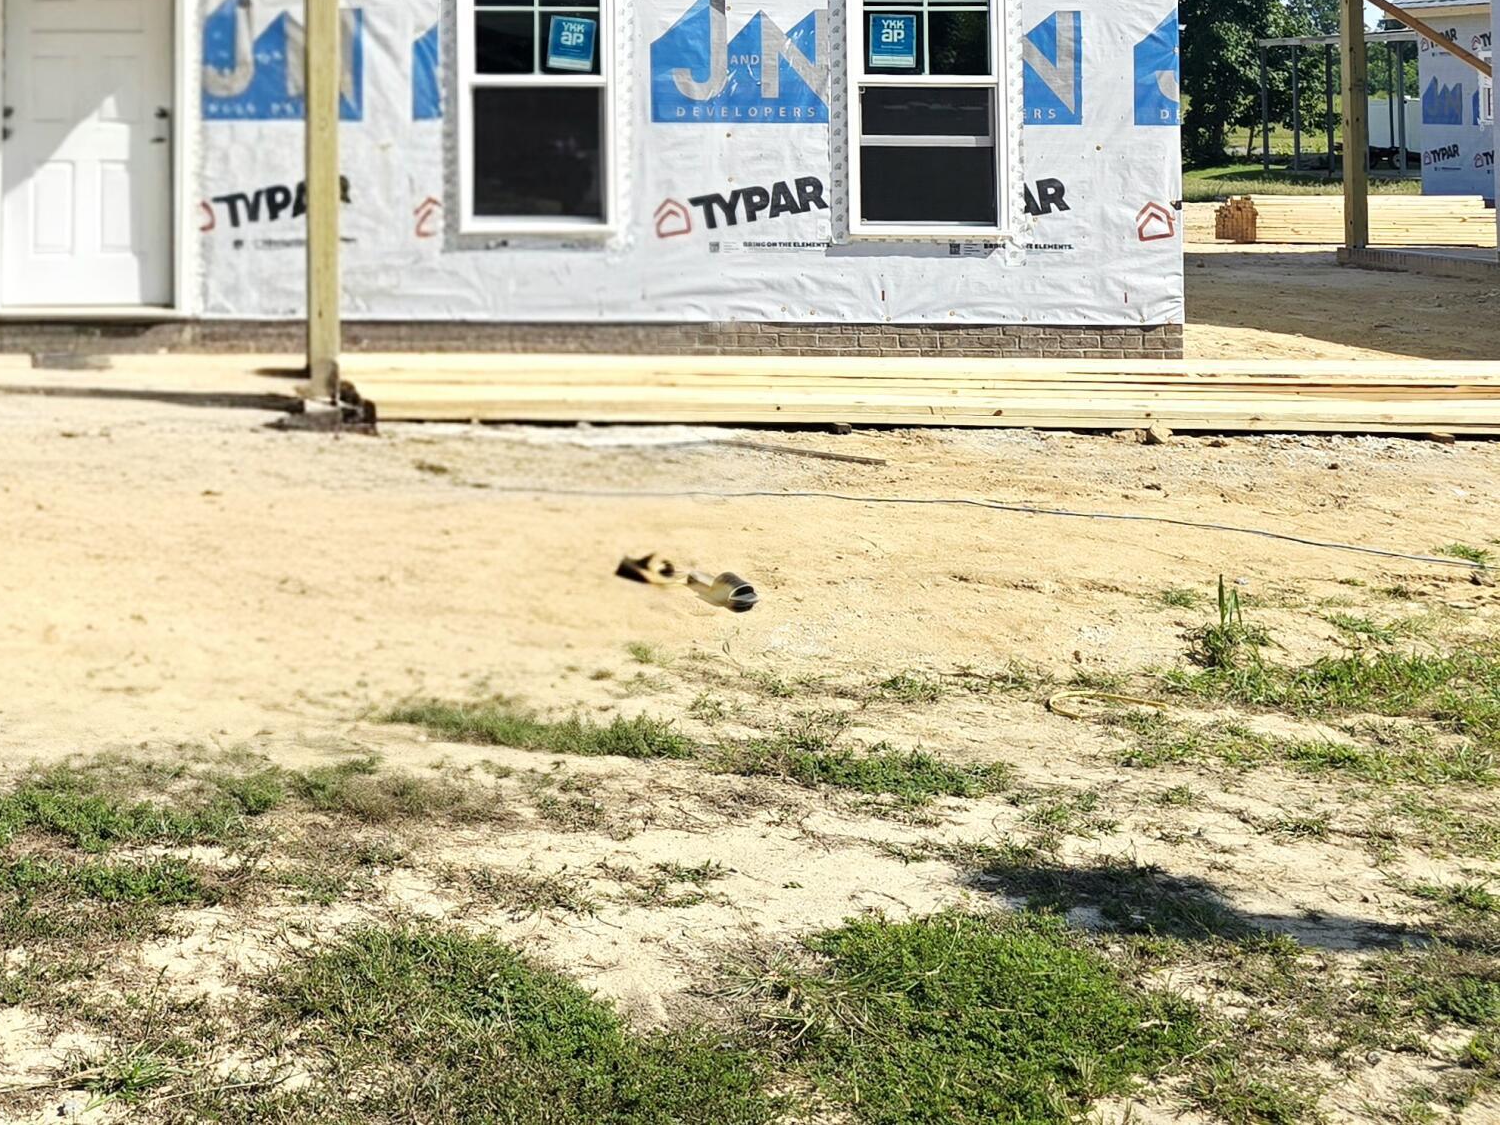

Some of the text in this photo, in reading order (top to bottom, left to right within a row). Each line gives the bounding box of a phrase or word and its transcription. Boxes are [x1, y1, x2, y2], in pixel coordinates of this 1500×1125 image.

[562, 21, 585, 32] YKK
[881, 19, 905, 29] YKK
[730, 54, 760, 64] AND
[676, 107, 816, 116] DEVELOPERS
[1430, 144, 1460, 163] TYPAR
[687, 176, 829, 229] TYPAR
